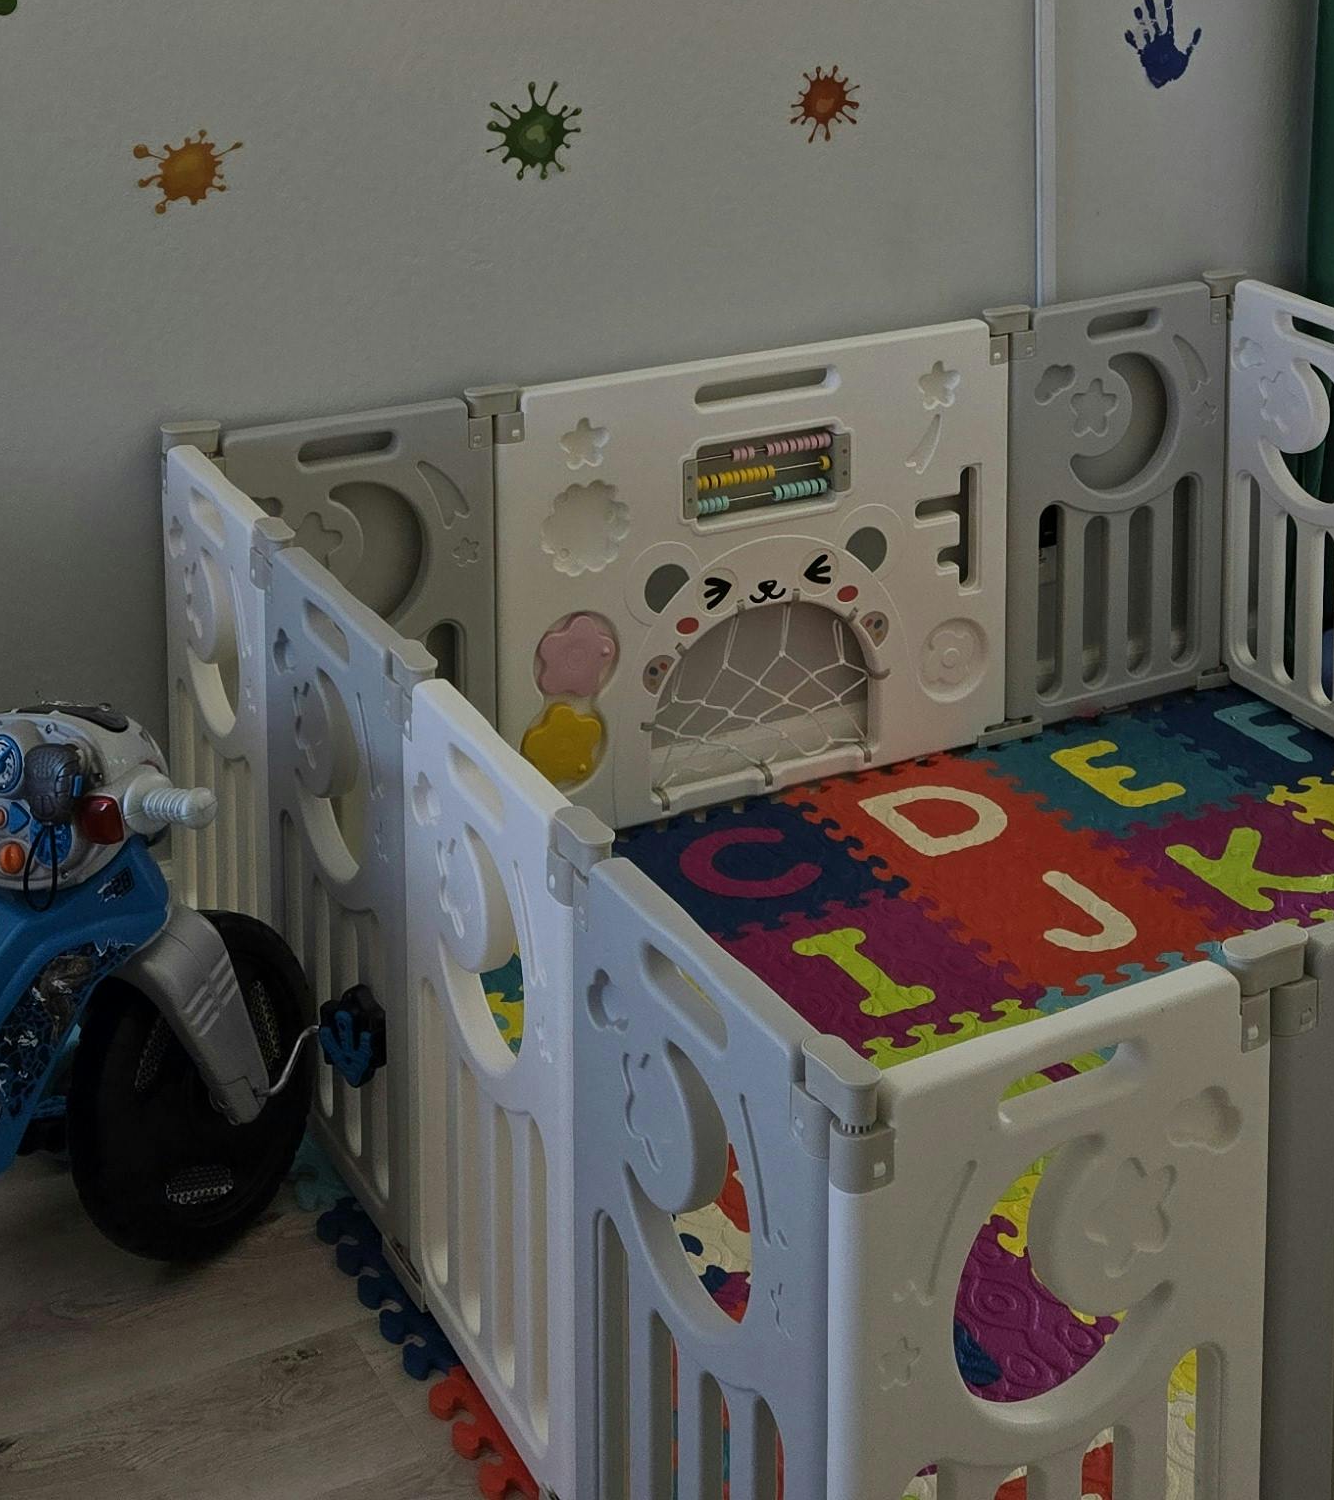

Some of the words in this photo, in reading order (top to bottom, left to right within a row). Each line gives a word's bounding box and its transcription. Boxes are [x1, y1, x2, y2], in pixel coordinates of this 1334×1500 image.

[678, 826, 822, 899] C
[859, 785, 1010, 857] D
[1051, 740, 1185, 809] E
[1214, 702, 1313, 763] F
[792, 927, 936, 1018] I
[1042, 870, 1138, 952] J
